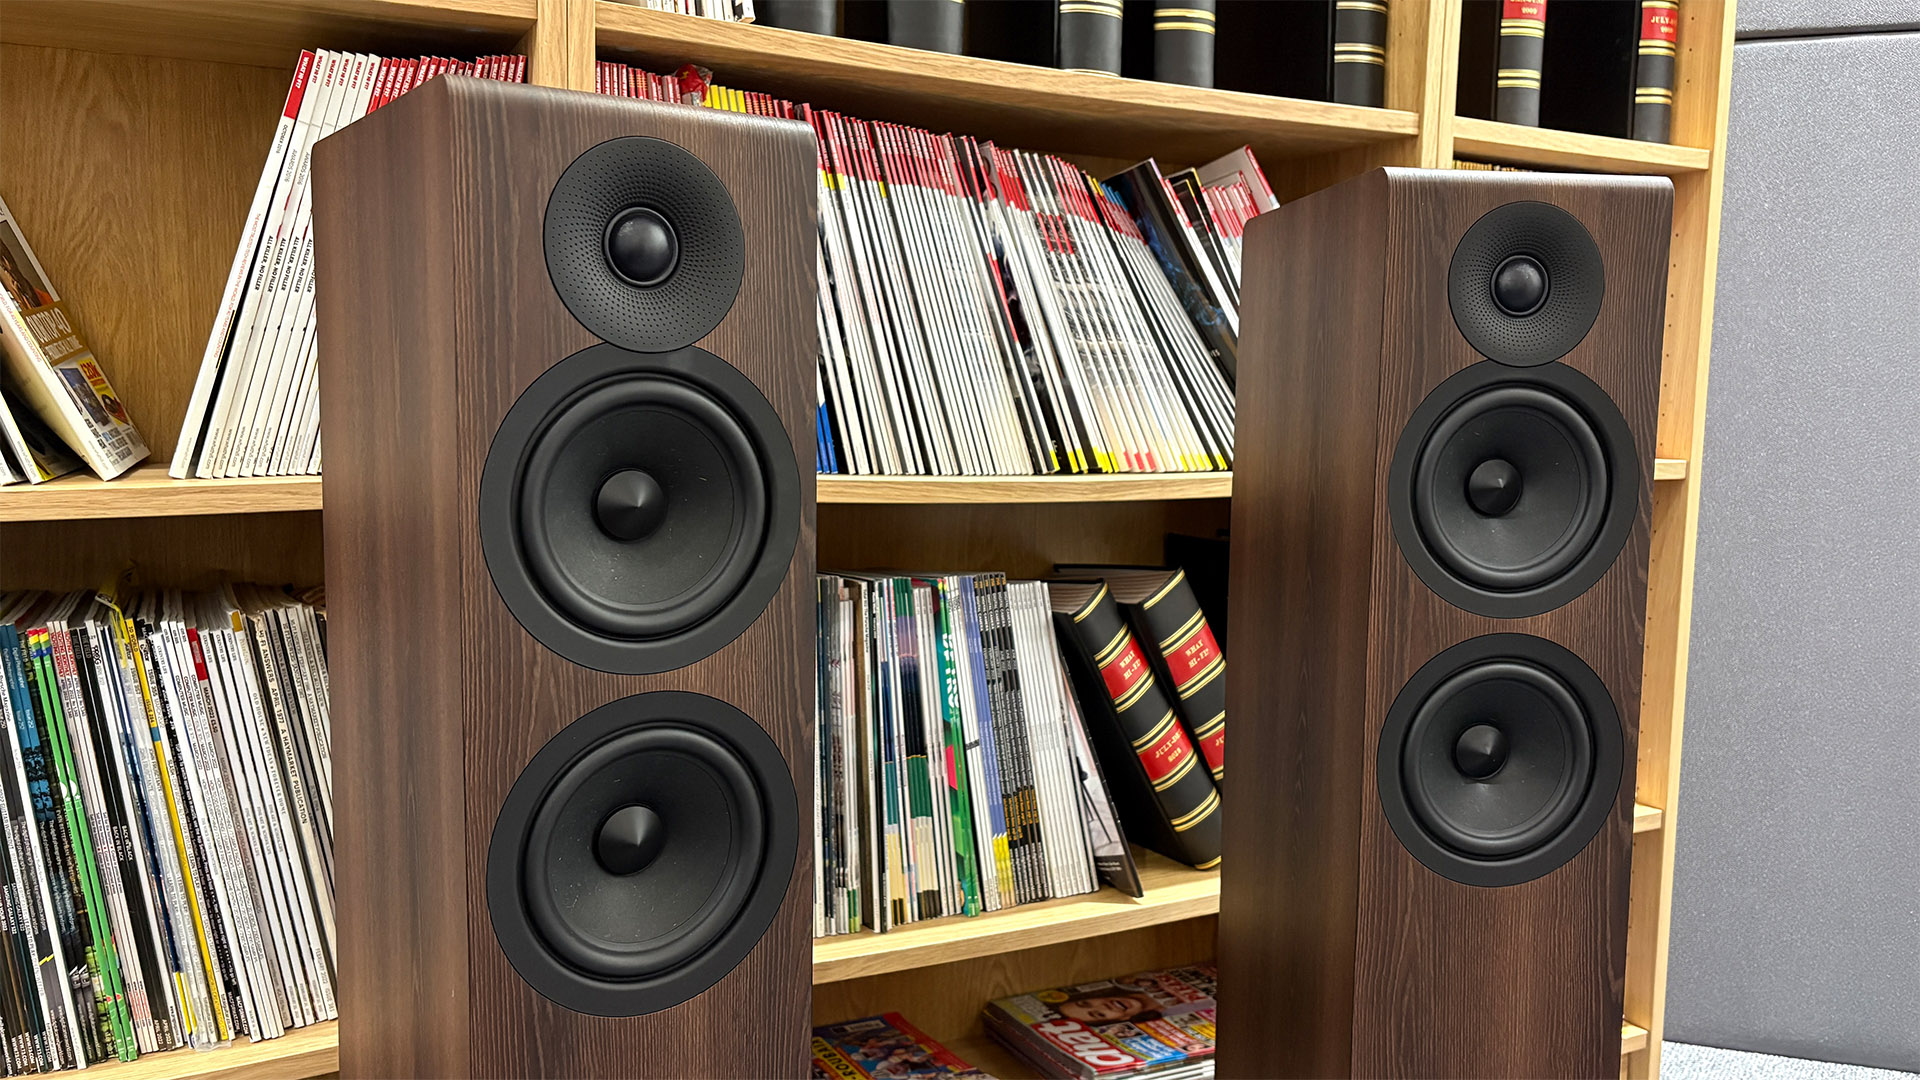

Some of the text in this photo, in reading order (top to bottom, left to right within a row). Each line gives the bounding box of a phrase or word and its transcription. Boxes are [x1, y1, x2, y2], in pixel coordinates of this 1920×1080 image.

[299, 56, 308, 72] WHAT
[315, 55, 323, 69] WHAT
[328, 59, 336, 73] WHAT
[341, 58, 350, 72] WHAT
[354, 61, 362, 75] WHAT
[367, 62, 375, 76] WHAT
[254, 235, 274, 290] ALL KILLER, NO FILLER
[274, 247, 284, 266] KILLER,
[280, 236, 300, 290] ALL KILLER, NO FILLER
[300, 248, 310, 267] KILLER,
[271, 267, 278, 276] NO
[298, 267, 305, 276] NO
[267, 275, 276, 292] FILLER
[293, 276, 303, 293] FILLER
[128, 625, 138, 652] 3D WORLD
[257, 629, 264, 639] HI
[259, 639, 266, 647] FI
[90, 644, 101, 665] PROG
[261, 648, 275, 683] ANSWERS
[175, 674, 185, 701] COMPUTER
[183, 675, 197, 717] COMPUTER MUSIC
[190, 674, 200, 700] COMPUTER
[196, 700, 204, 716] MUSIC
[270, 687, 280, 707] APRIL
[202, 686, 211, 705] MARCH
[210, 719, 218, 733] £5.50
[275, 709, 284, 724] 1977
[282, 735, 297, 778] HAYMARKET
[292, 779, 308, 824] PUBLICATION
[111, 825, 119, 839] BACK
[116, 845, 124, 861] BLACK
[120, 824, 128, 838] BACK
[125, 844, 134, 860] BLACK
[1, 884, 12, 907] SAMSUNG
[9, 882, 20, 904] SAMSUNG
[15, 904, 24, 923] GALAXY
[6, 907, 16, 926] GALAXY
[164, 1032, 172, 1044] 2022
